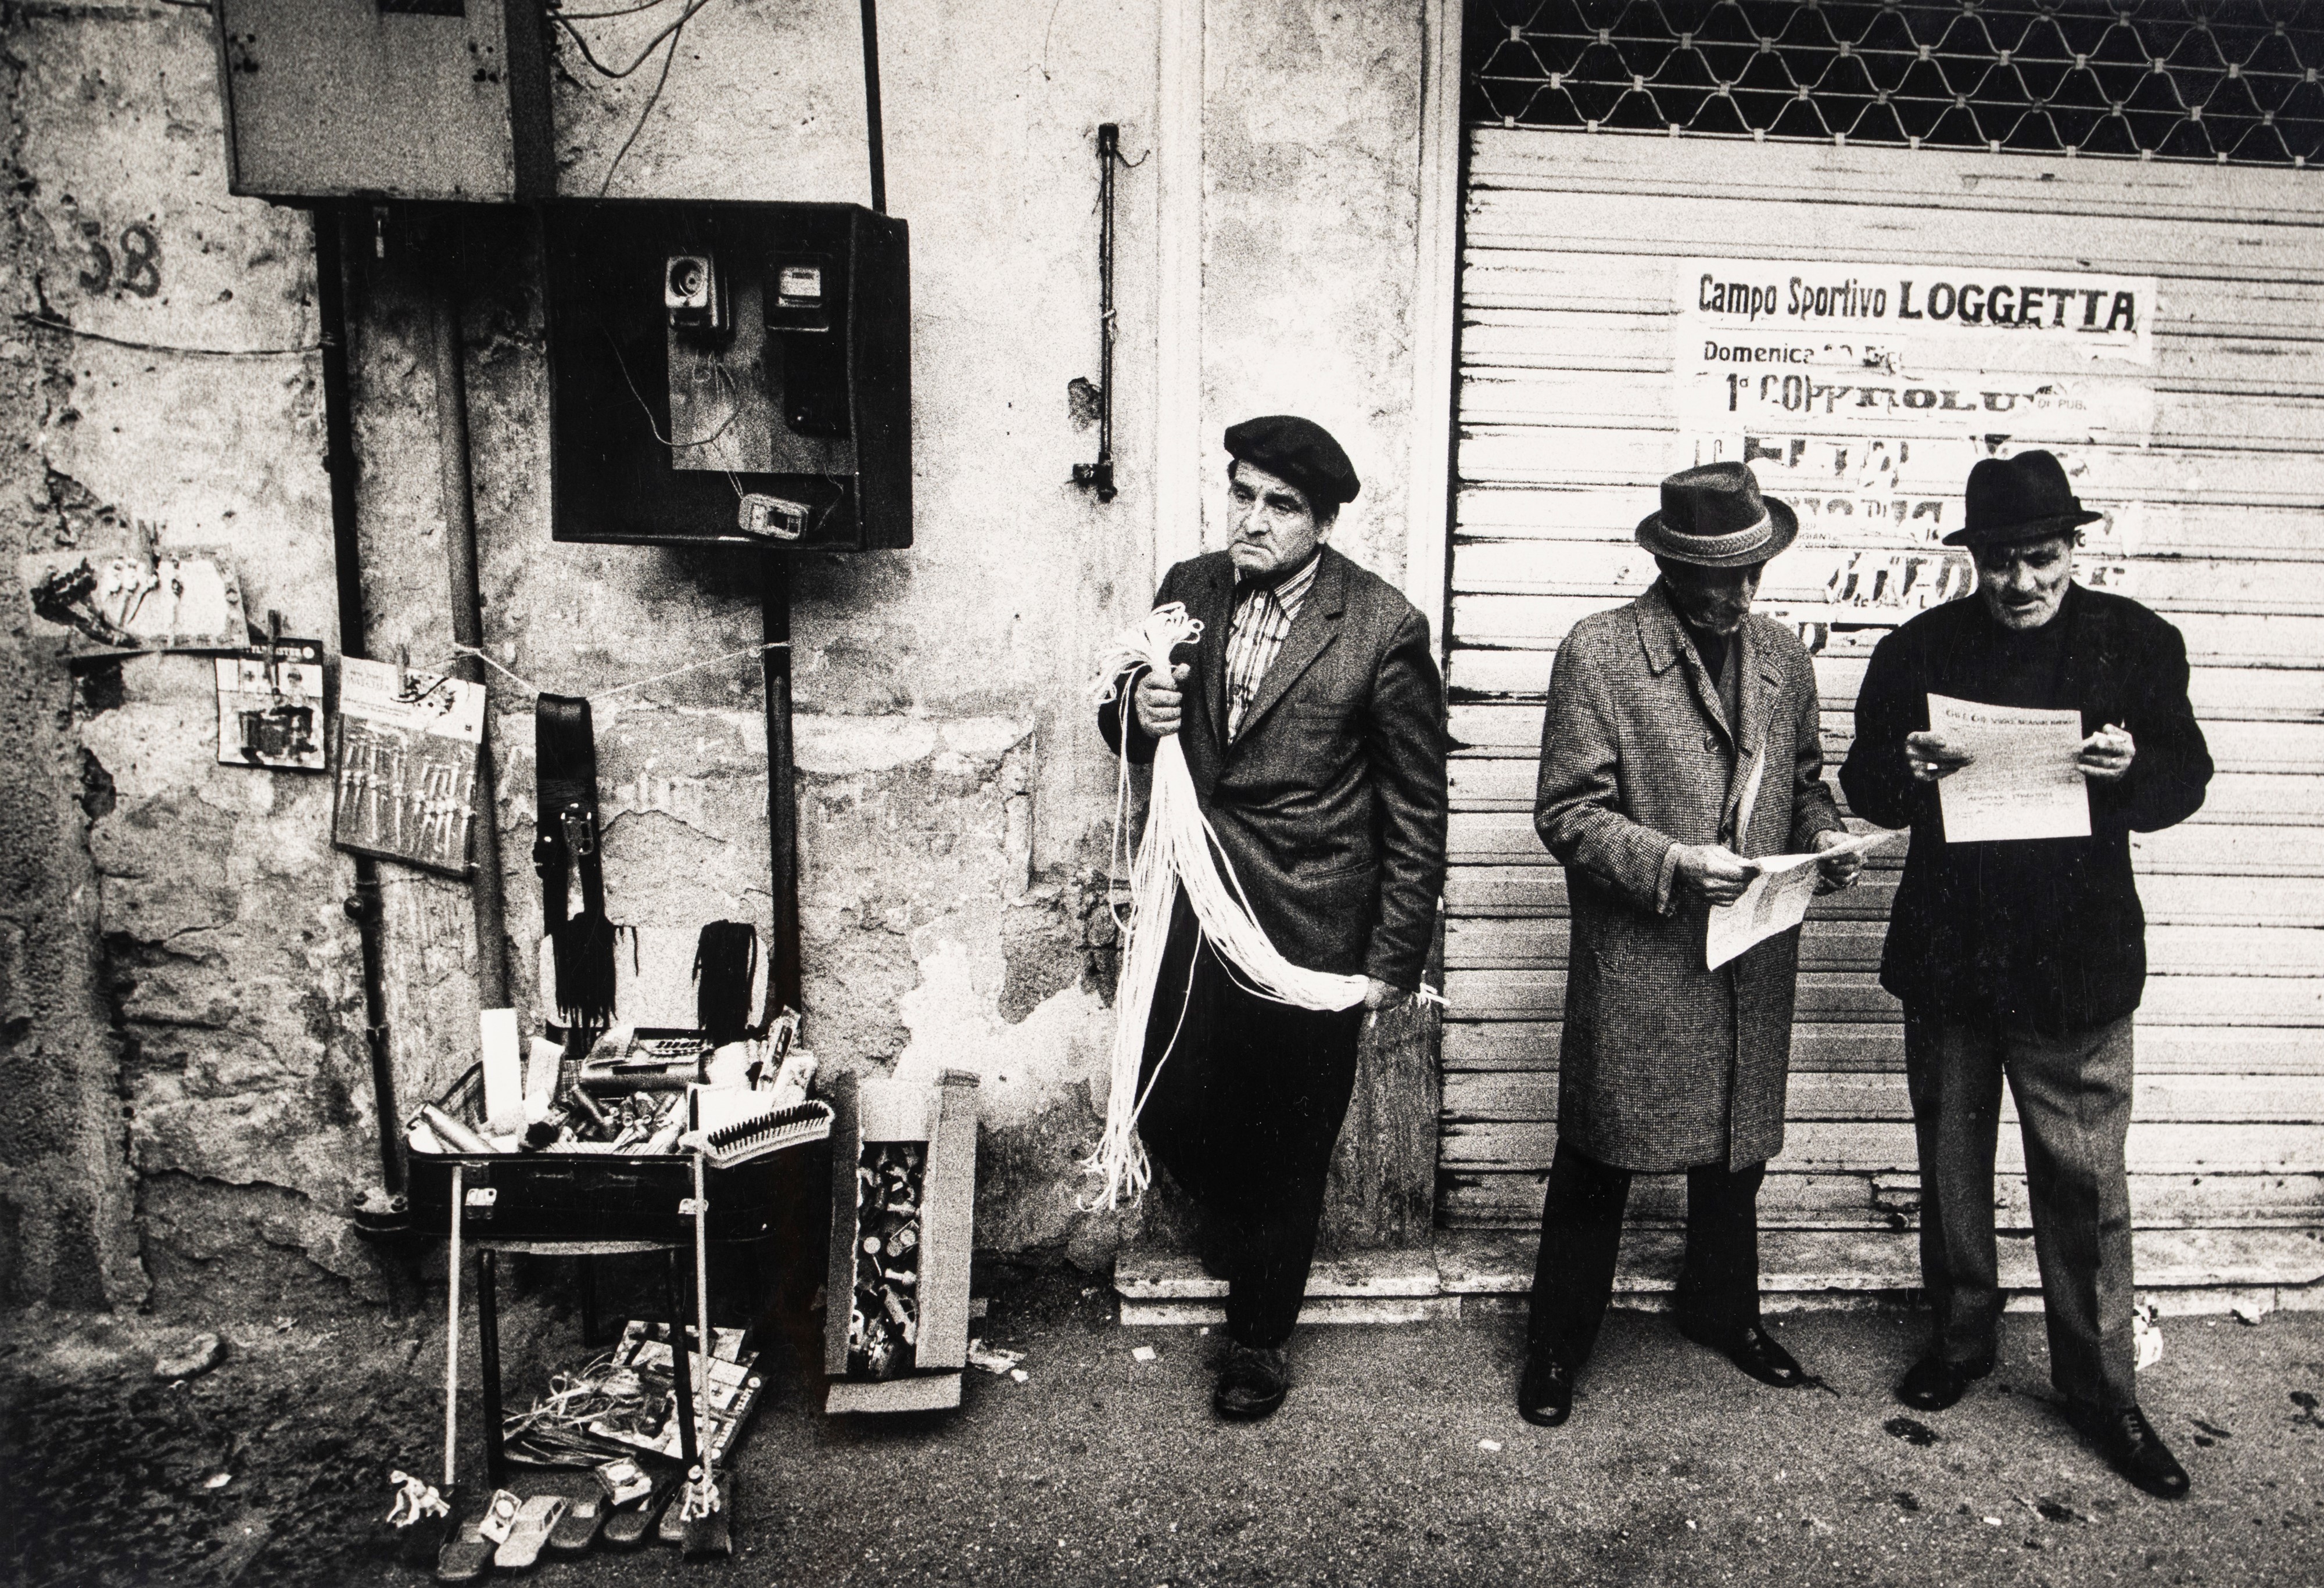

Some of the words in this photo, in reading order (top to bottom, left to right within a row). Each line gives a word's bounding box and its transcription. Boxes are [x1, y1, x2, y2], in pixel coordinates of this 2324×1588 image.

[1699, 273, 1777, 321] Campo
[1788, 276, 1887, 321] Sportivo
[1898, 281, 2136, 330] LOGGETTA
